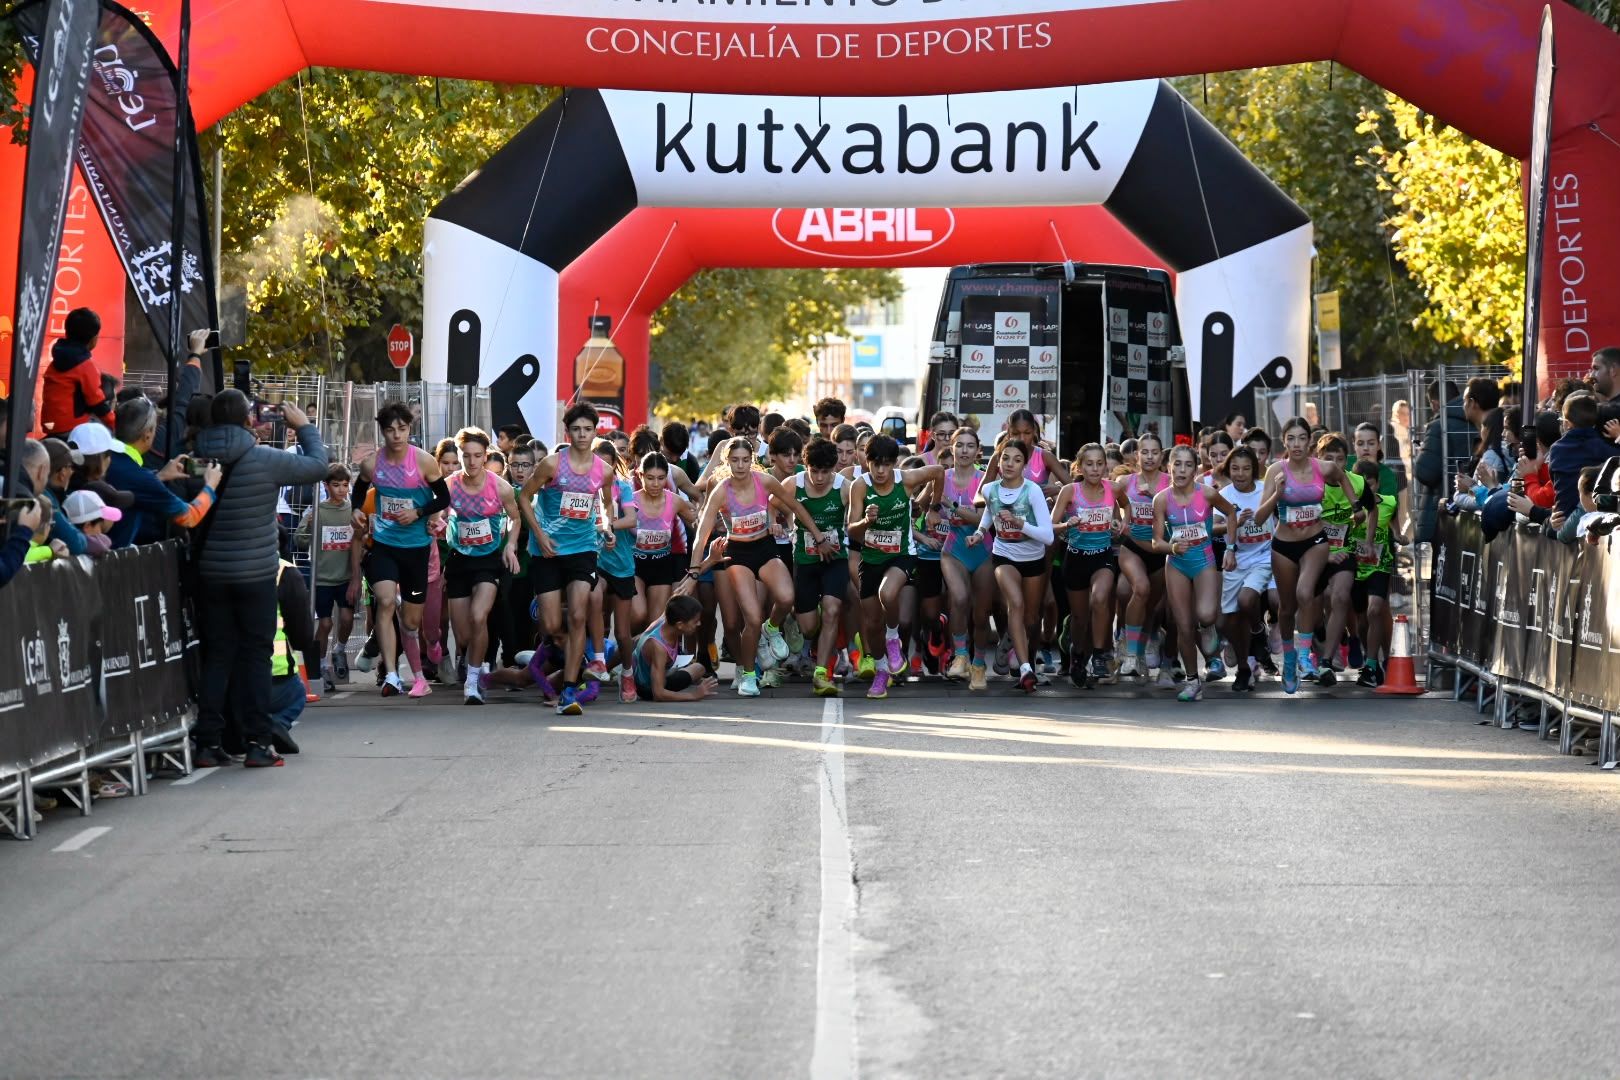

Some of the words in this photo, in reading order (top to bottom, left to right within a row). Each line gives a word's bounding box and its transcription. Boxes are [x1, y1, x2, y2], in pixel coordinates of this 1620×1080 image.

[586, 25, 800, 60] CONCEJALÍA
[816, 33, 860, 58] DE
[876, 22, 1053, 58] DEPORTES
[656, 102, 1101, 174] kutxabank
[797, 208, 932, 242] ABRIL
[48, 185, 88, 361] EPORTES
[1553, 173, 1590, 353] DEPORTES
[390, 341, 409, 352] STOP
[570, 498, 589, 508] 2034
[1088, 513, 1105, 522] 2051
[330, 531, 348, 541] 2005
[873, 534, 893, 544] 2023
